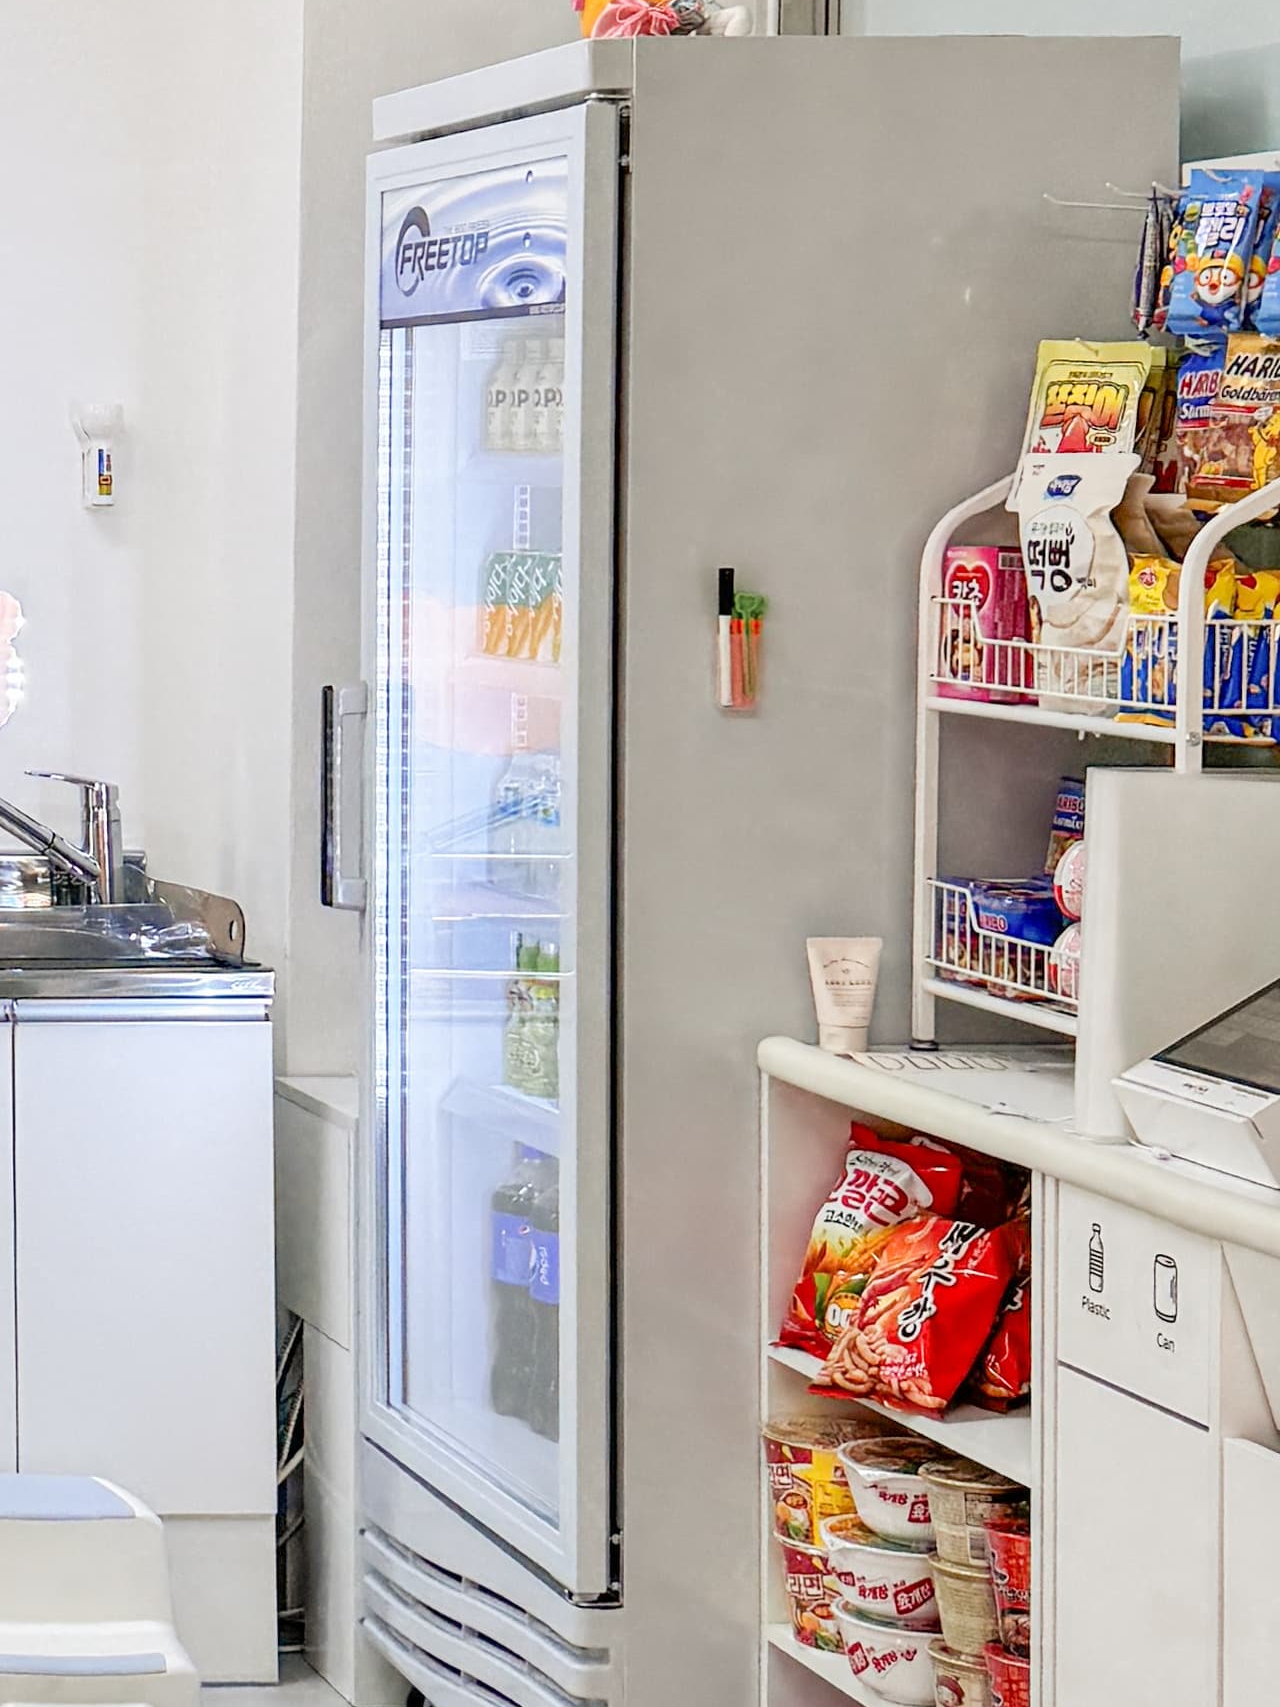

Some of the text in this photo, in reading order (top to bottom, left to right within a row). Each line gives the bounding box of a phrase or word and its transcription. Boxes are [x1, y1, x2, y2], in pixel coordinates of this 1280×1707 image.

[400, 231, 489, 281] FREETOP
[898, 1223, 985, 1342] 새우깡
[1081, 1295, 1111, 1321] Plastic
[1157, 1332, 1176, 1353] Can
